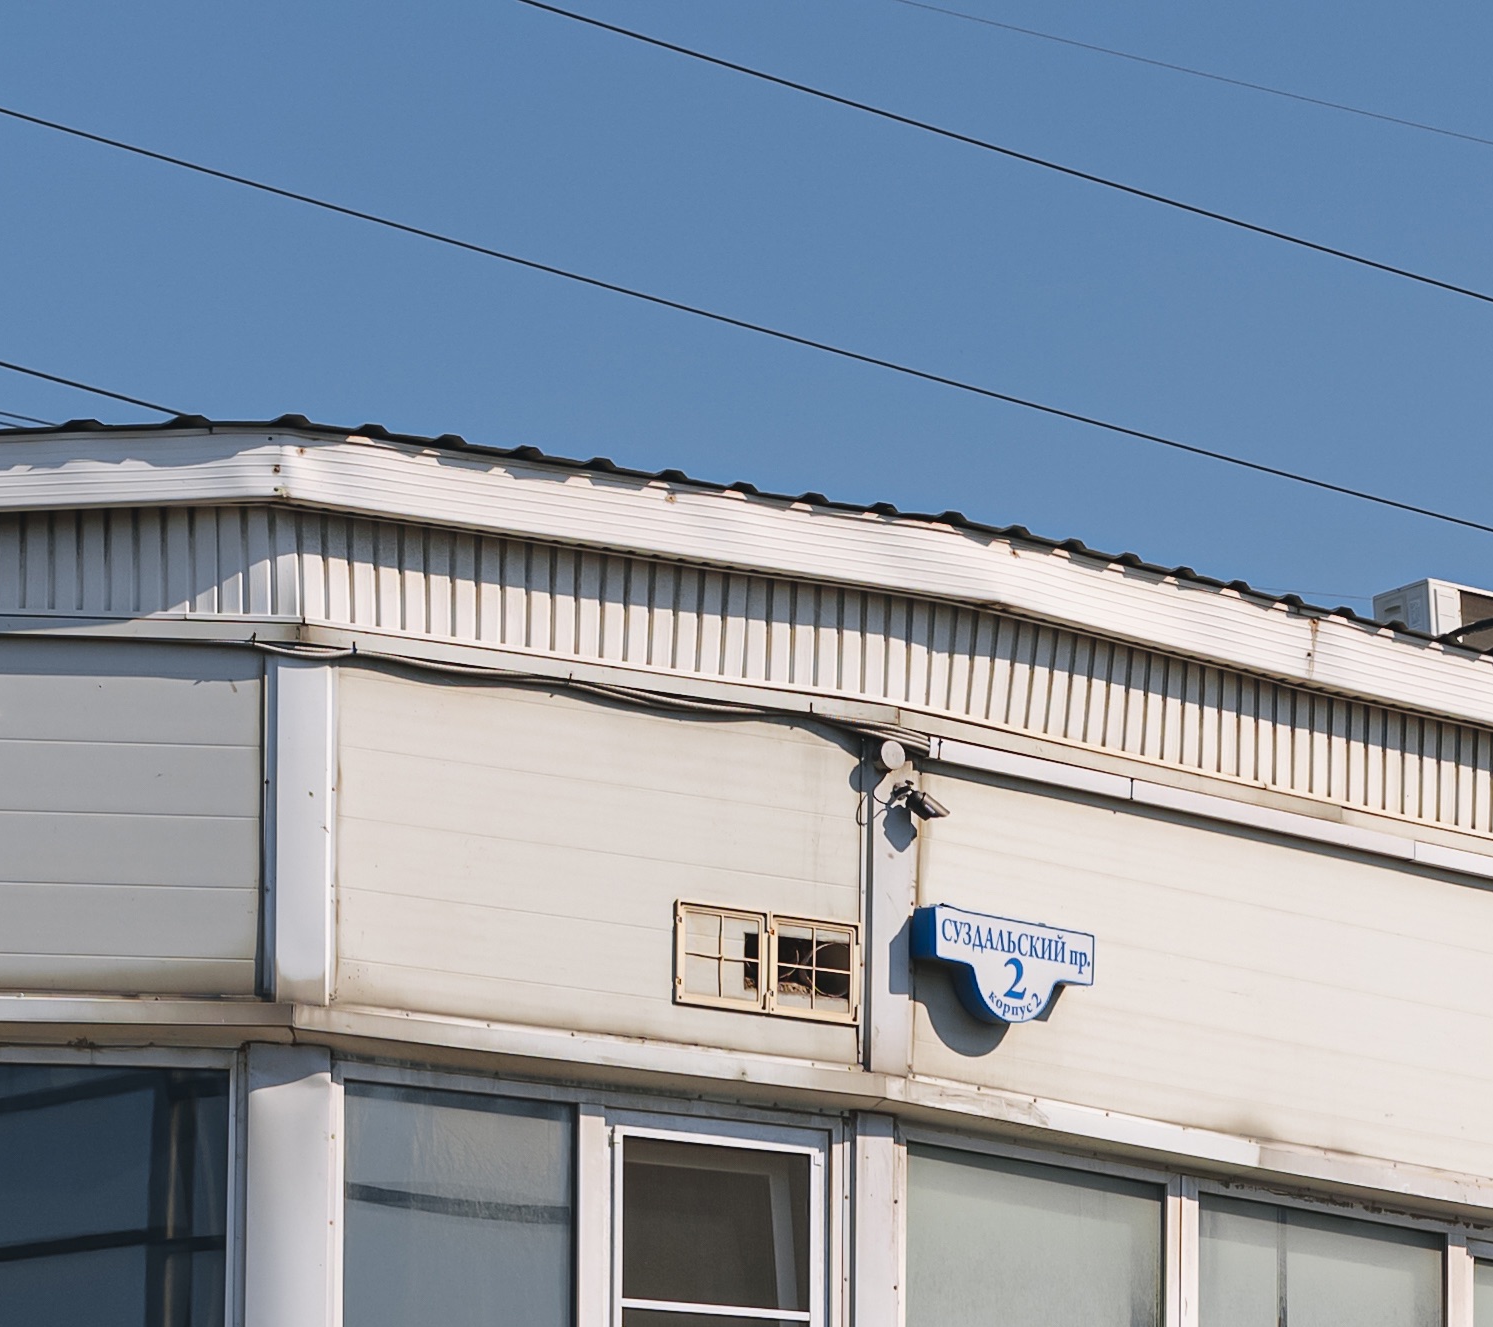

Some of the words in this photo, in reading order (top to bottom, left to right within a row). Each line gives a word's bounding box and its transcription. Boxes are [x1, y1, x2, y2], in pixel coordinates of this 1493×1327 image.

[941, 918, 1066, 964] СУЗДАЛЬСКИЙ
[1069, 949, 1091, 974] пр.
[1003, 957, 1027, 1000] 2
[988, 991, 1033, 1019] корпус
[1031, 992, 1042, 1007] 2
